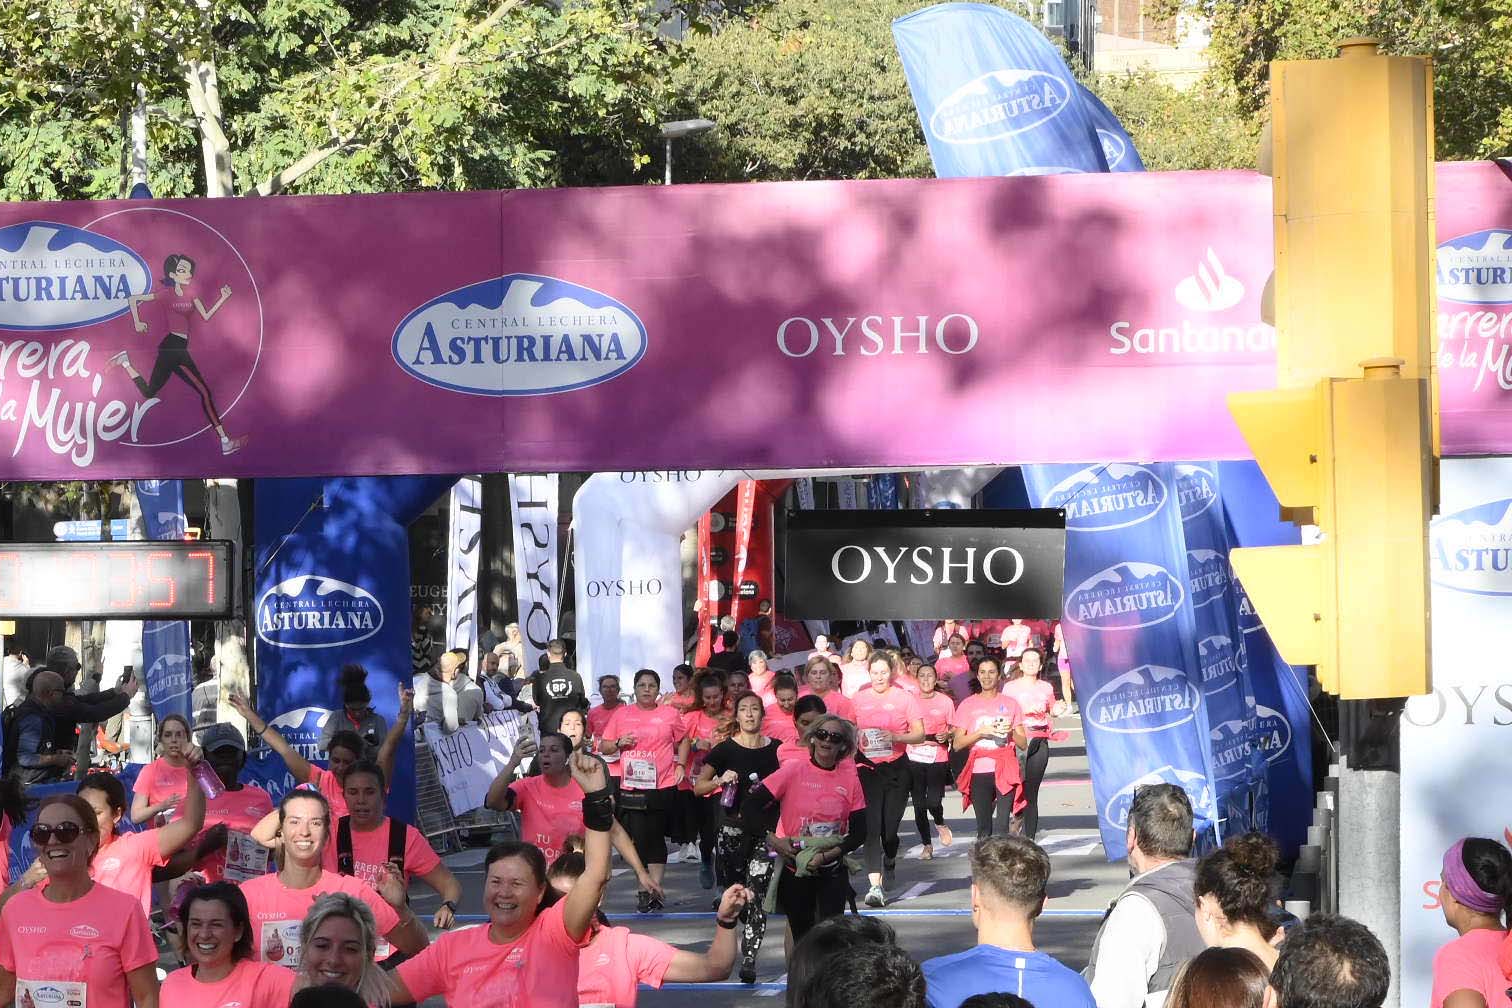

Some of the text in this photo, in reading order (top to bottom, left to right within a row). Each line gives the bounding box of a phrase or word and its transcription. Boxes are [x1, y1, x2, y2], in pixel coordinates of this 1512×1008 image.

[54, 257, 126, 269] LECHERA
[452, 314, 619, 330] CENTRAL LECHERA
[776, 313, 979, 358] OYSHO
[412, 322, 627, 366] ASTURIANA
[11, 375, 162, 467] Mujer
[831, 544, 1024, 587] OYSHO
[587, 578, 662, 598] OYSHO
[261, 604, 375, 633] ASTURIANA
[1404, 685, 1512, 727] OYS
[536, 834, 551, 844] TU
